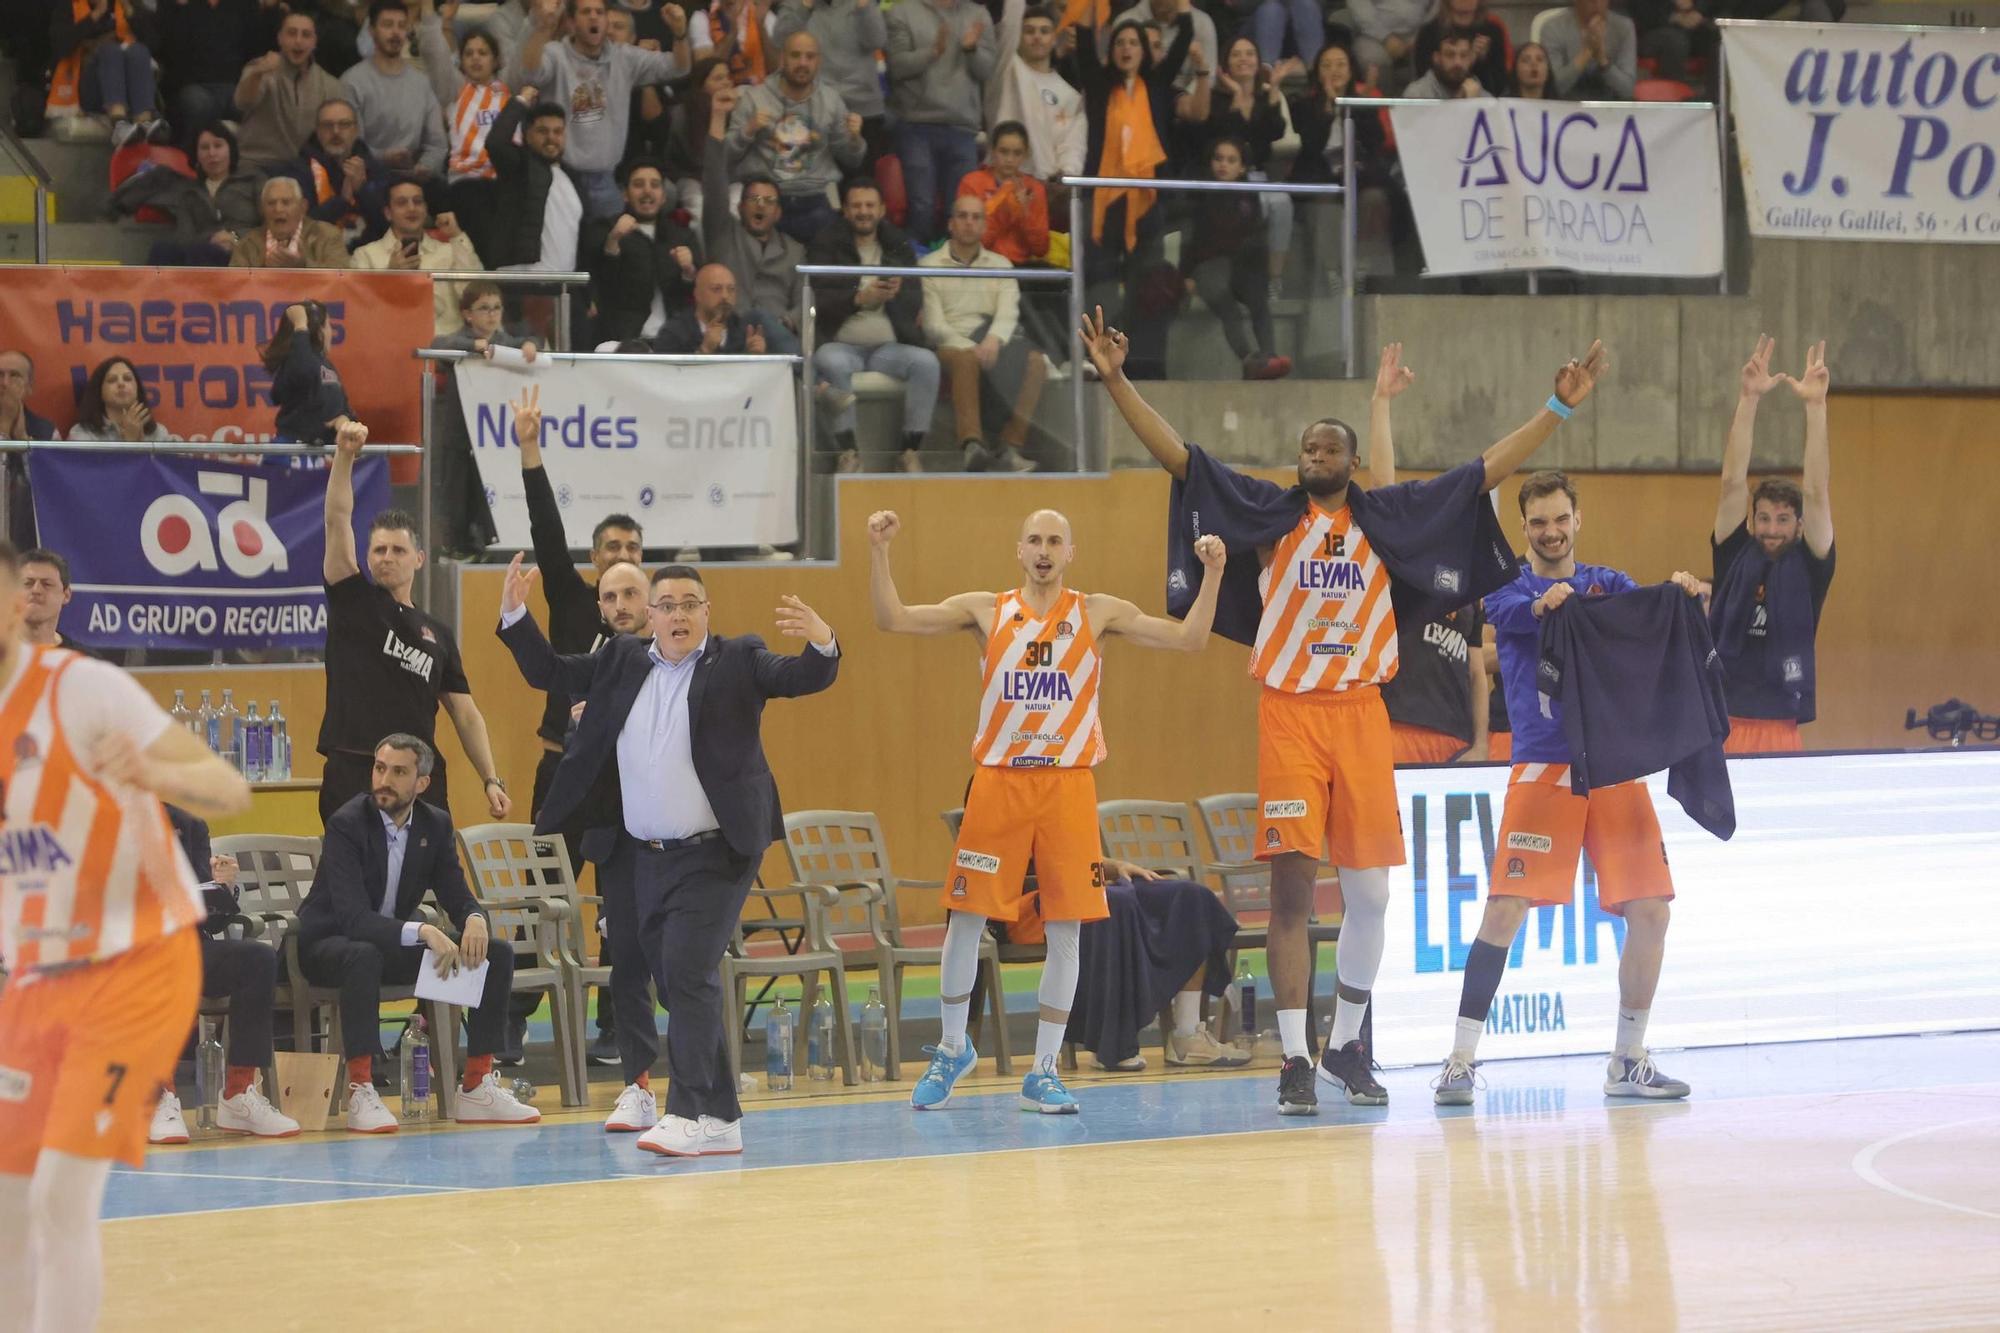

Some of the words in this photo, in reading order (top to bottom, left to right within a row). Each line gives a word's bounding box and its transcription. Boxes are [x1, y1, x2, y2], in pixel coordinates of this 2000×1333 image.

[1457, 107, 1649, 192] AUGA
[1781, 112, 1848, 198] J.
[1878, 114, 2000, 201] Po
[1460, 196, 1505, 241] DE
[1524, 195, 1653, 243] PARADA
[1766, 206, 1832, 233] Galileo
[1914, 211, 1937, 232] 56
[1953, 213, 1968, 233] A
[666, 396, 772, 449] ancín
[1323, 532, 1345, 556] 12
[1299, 560, 1366, 591] LEYMA
[1321, 591, 1347, 599] NATURA
[88, 602, 121, 633] AD
[128, 603, 217, 635] GRUPO
[224, 603, 328, 635] REGUEIRA
[383, 629, 434, 684] LEYMA
[1025, 641, 1053, 667] 30
[1003, 671, 1073, 701] LEYMA
[1024, 703, 1052, 711] NATURA
[1486, 992, 1566, 1035] NATURA
[103, 1063, 127, 1104] 7
